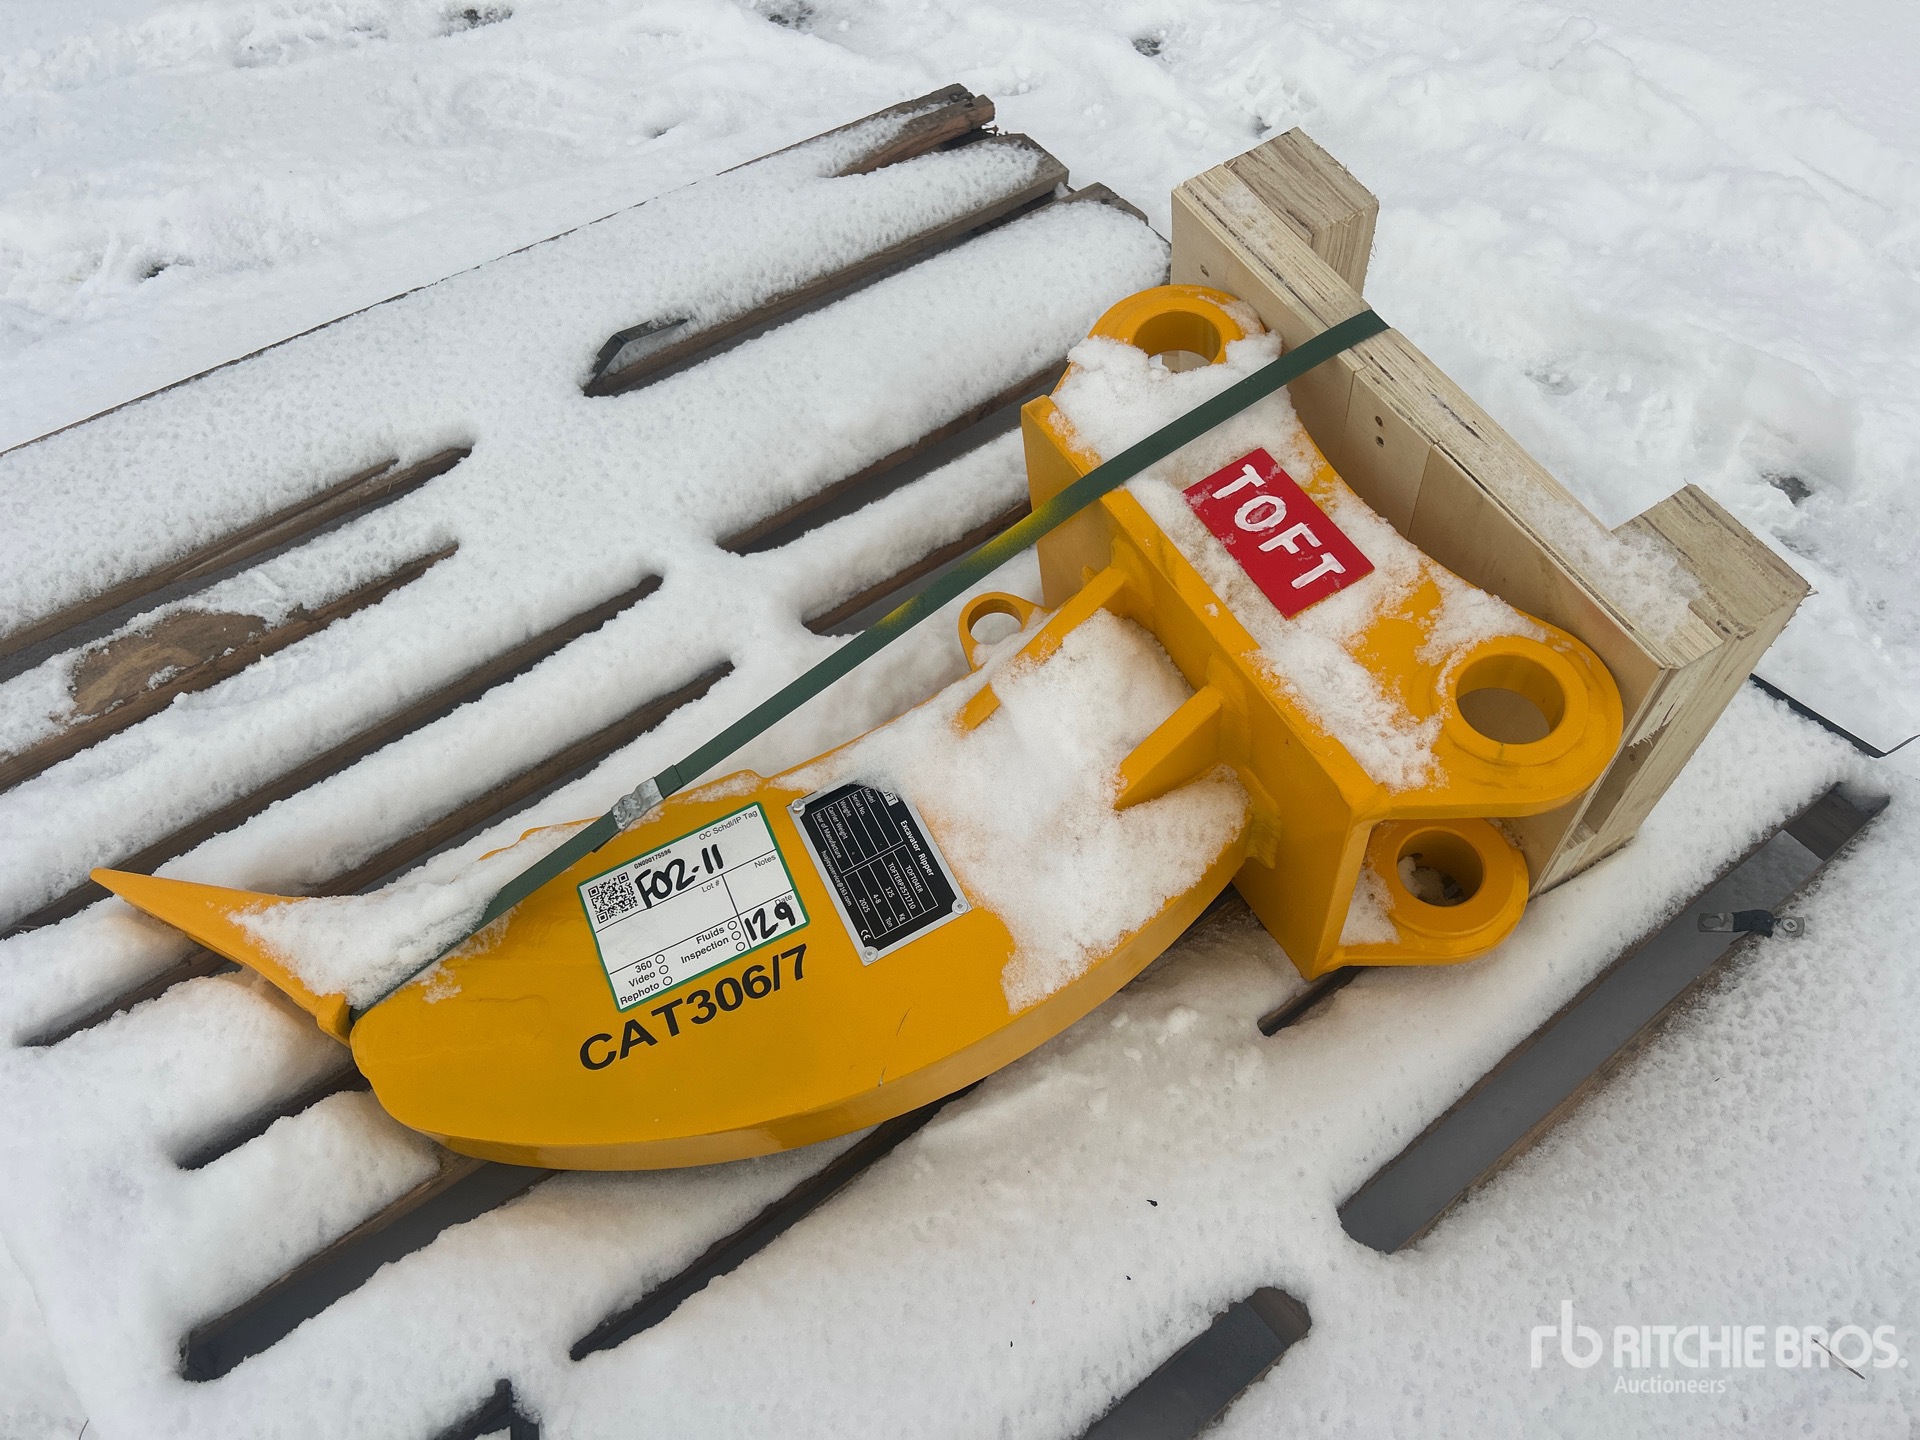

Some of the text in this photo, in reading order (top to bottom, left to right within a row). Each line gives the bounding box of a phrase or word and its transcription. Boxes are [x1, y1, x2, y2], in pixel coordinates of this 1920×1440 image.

[1212, 463, 1346, 589] TOFT
[852, 794, 866, 816] Serial No.
[864, 788, 876, 803] Model
[840, 800, 852, 817] Weight
[699, 830, 711, 840] OC
[743, 810, 758, 823] Tag
[827, 806, 848, 840] Carrier Weight
[815, 813, 823, 824] Year
[824, 828, 842, 858] Manufacture
[901, 820, 934, 876] Excavator Ripper
[754, 855, 776, 869] Notes
[701, 882, 714, 893] Lot
[906, 865, 924, 893] TOFT04ER
[859, 898, 870, 913] 2025
[873, 894, 882, 904] 4-8
[885, 887, 906, 922] 125 Kg
[696, 927, 725, 944] Fluids
[860, 930, 871, 941] CE
[681, 937, 729, 964] Inspection
[635, 961, 652, 973] 360
[628, 971, 656, 988] Video
[620, 982, 660, 1005] Rephoto
[580, 944, 808, 1071] CAT306/7
